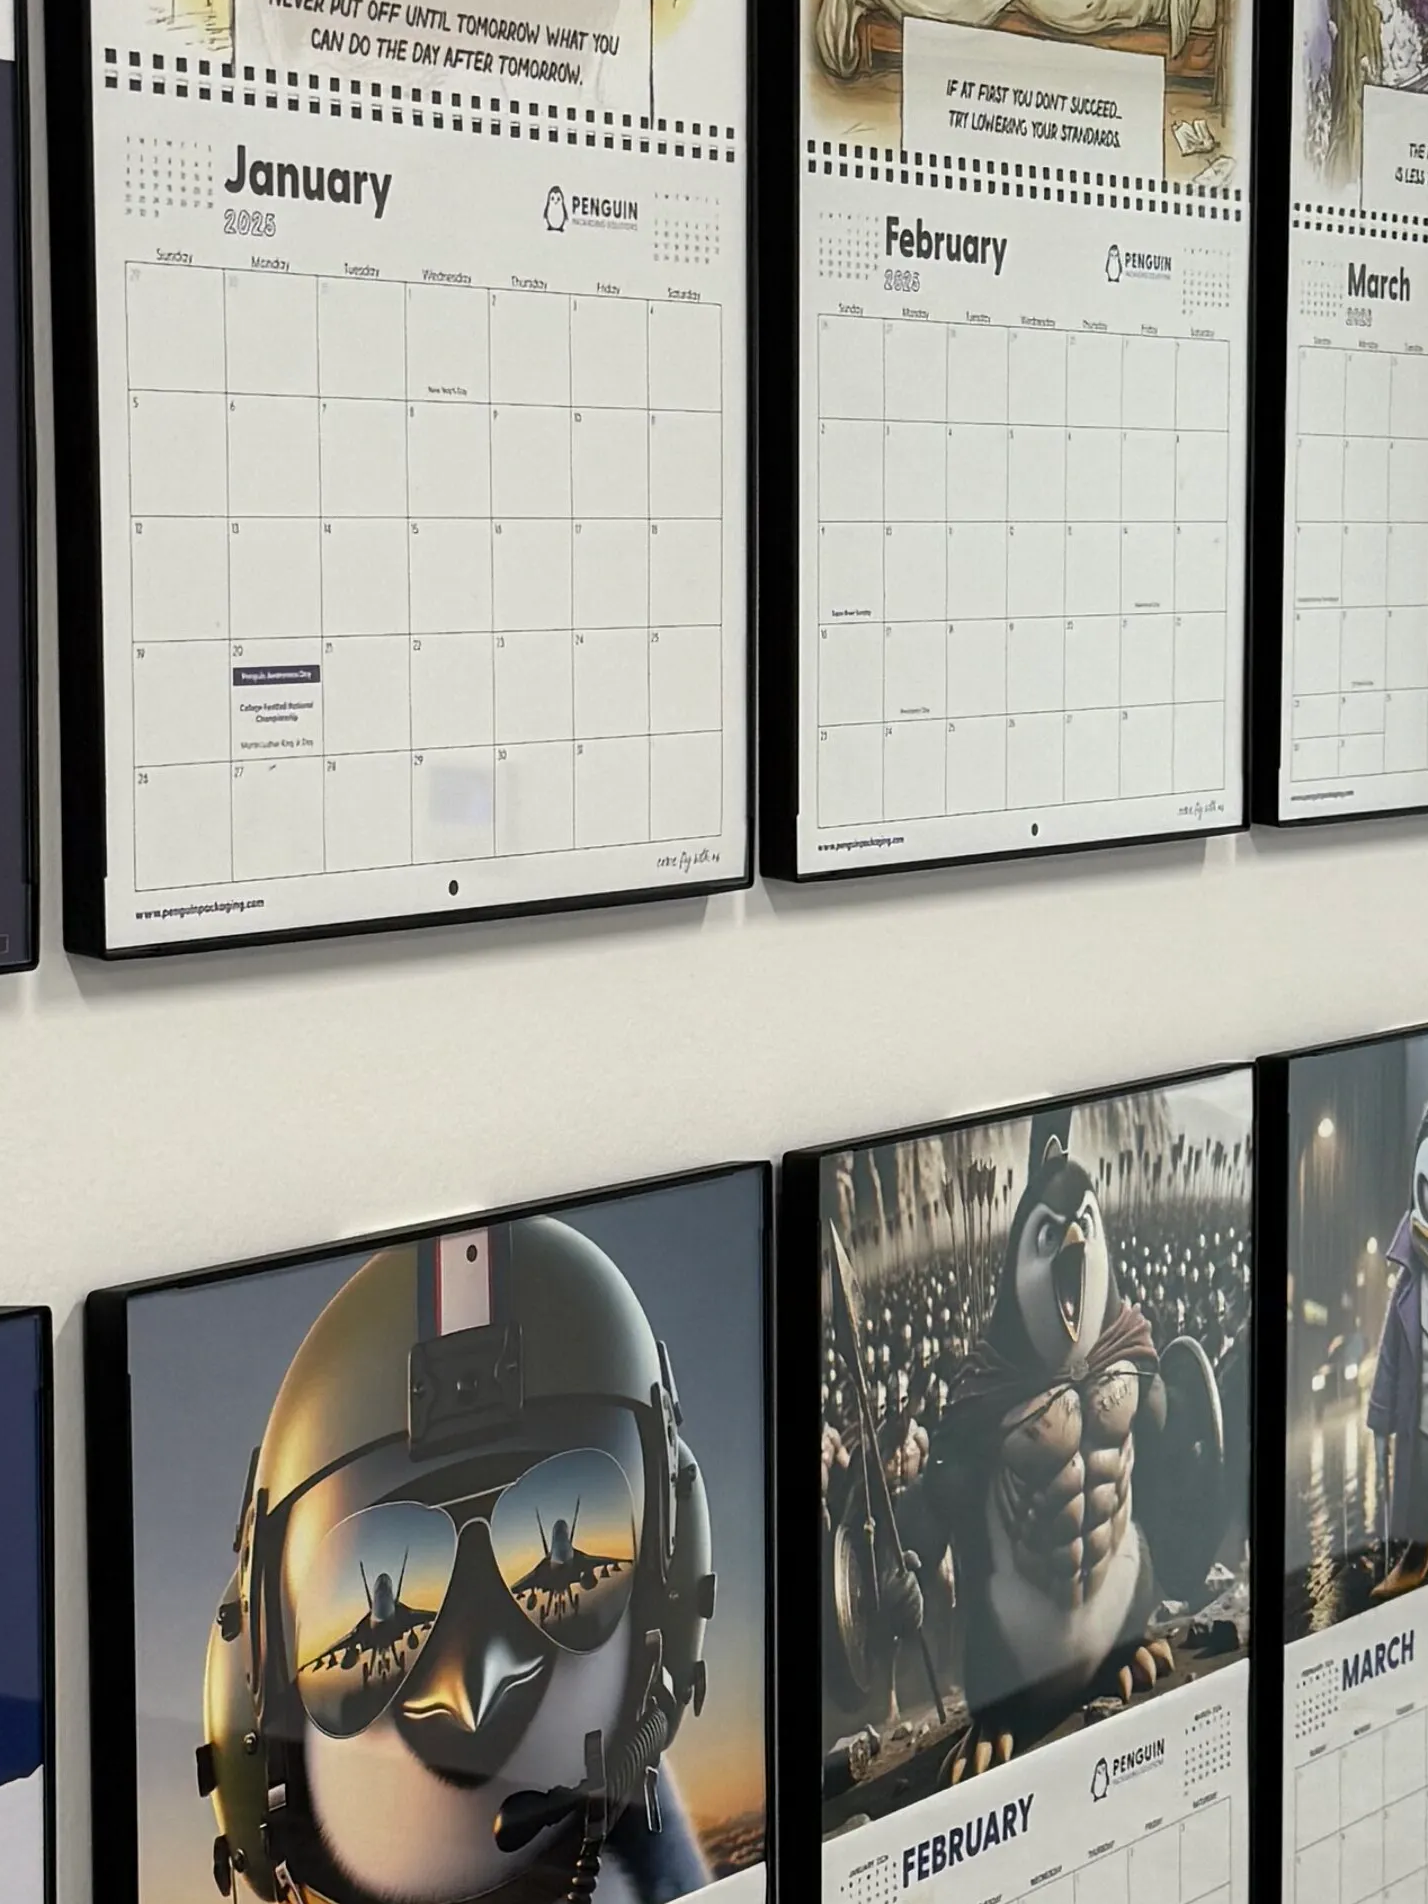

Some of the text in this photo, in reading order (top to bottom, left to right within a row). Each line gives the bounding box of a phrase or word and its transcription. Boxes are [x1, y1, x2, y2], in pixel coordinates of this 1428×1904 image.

[368, 0, 402, 22] OFF
[406, 6, 450, 31] UNTIL
[457, 14, 540, 43] TOMORROW
[546, 26, 589, 50] WHAT
[593, 34, 619, 55] YOU
[312, 28, 582, 84] CAN DO THE DAY AFTER TOMORROW.
[947, 80, 958, 95] IF
[960, 82, 976, 98] AT
[978, 84, 1009, 103] FIRST
[1013, 89, 1033, 107] YOU
[949, 110, 969, 128] TRY
[972, 114, 1027, 136] LOWERING
[1032, 122, 1058, 139] YOUR
[224, 145, 392, 219] January
[224, 208, 276, 237] 2025
[572, 195, 638, 221] PENGUIN
[156, 248, 193, 264] Sunday
[251, 256, 290, 271] Monday
[885, 215, 1008, 276] February
[1124, 252, 1172, 272] PENGUIN
[1347, 262, 1410, 302] March
[1342, 1629, 1415, 1691] MARCH
[1112, 1737, 1165, 1776] PENGUIN
[901, 1793, 1034, 1889] FEBRUARY
